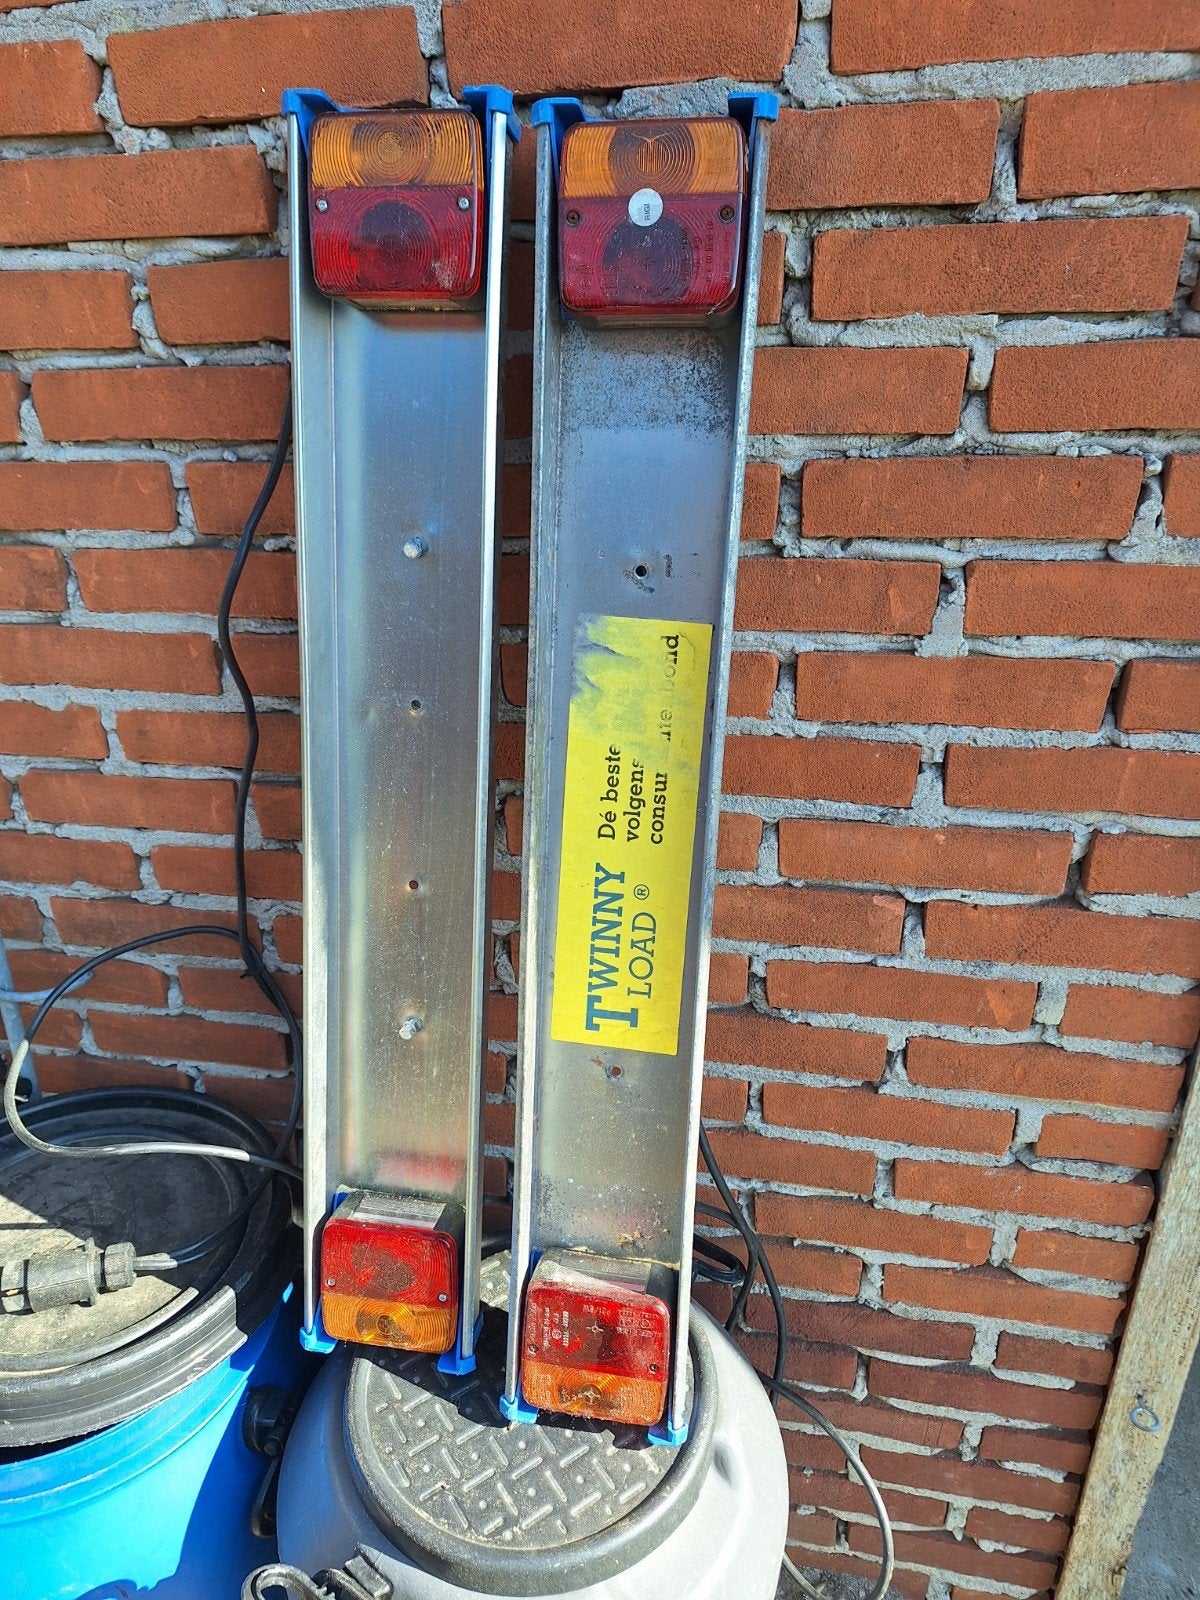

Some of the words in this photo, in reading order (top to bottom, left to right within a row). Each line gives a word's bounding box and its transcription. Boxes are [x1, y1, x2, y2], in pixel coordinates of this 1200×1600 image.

[643, 203, 651, 221] RIGI
[600, 743, 621, 803] beste
[623, 758, 646, 842] volgens
[597, 810, 617, 840] Dé
[585, 862, 639, 1031] TWINNY
[627, 911, 657, 999] LOAD
